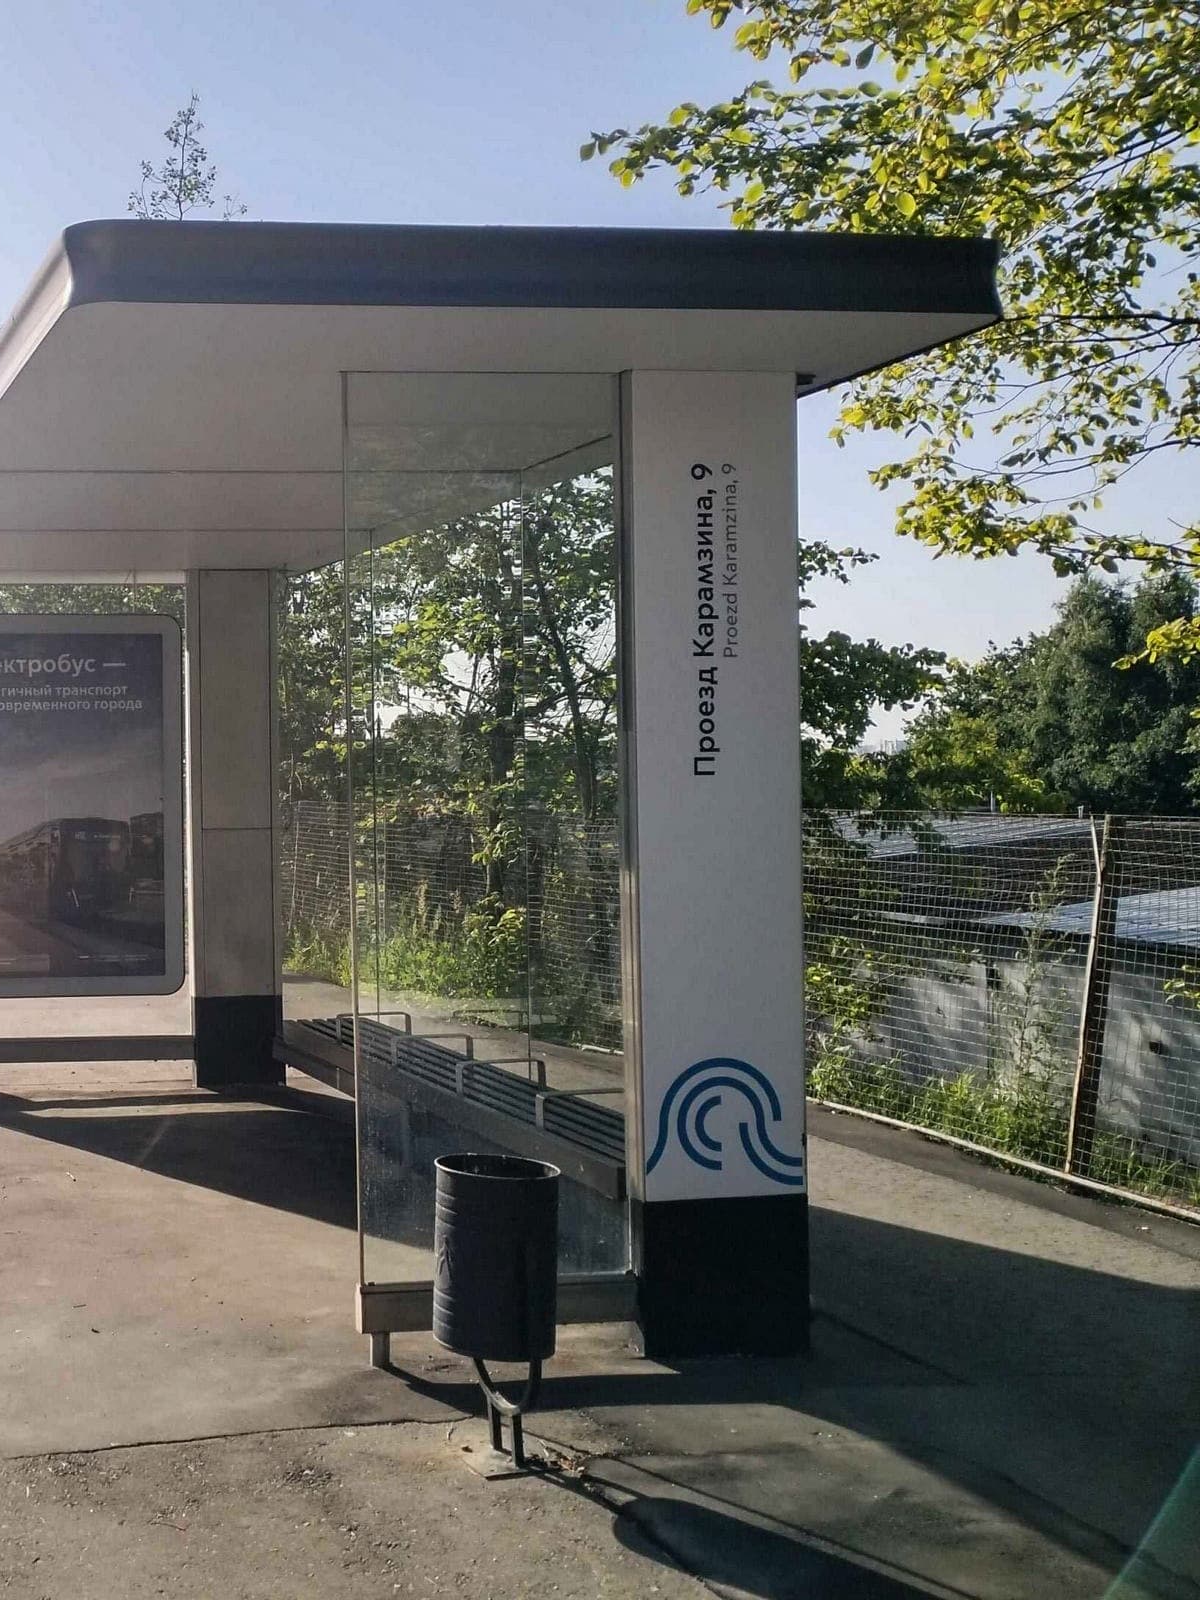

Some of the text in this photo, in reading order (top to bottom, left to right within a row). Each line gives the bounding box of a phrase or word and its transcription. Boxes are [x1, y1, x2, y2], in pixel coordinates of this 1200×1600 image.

[721, 463, 741, 658] Proezd Karamzina, 9
[691, 463, 720, 776] Проезд Карамзина, 9
[55, 685, 128, 699] транспорт
[94, 699, 143, 712] города
